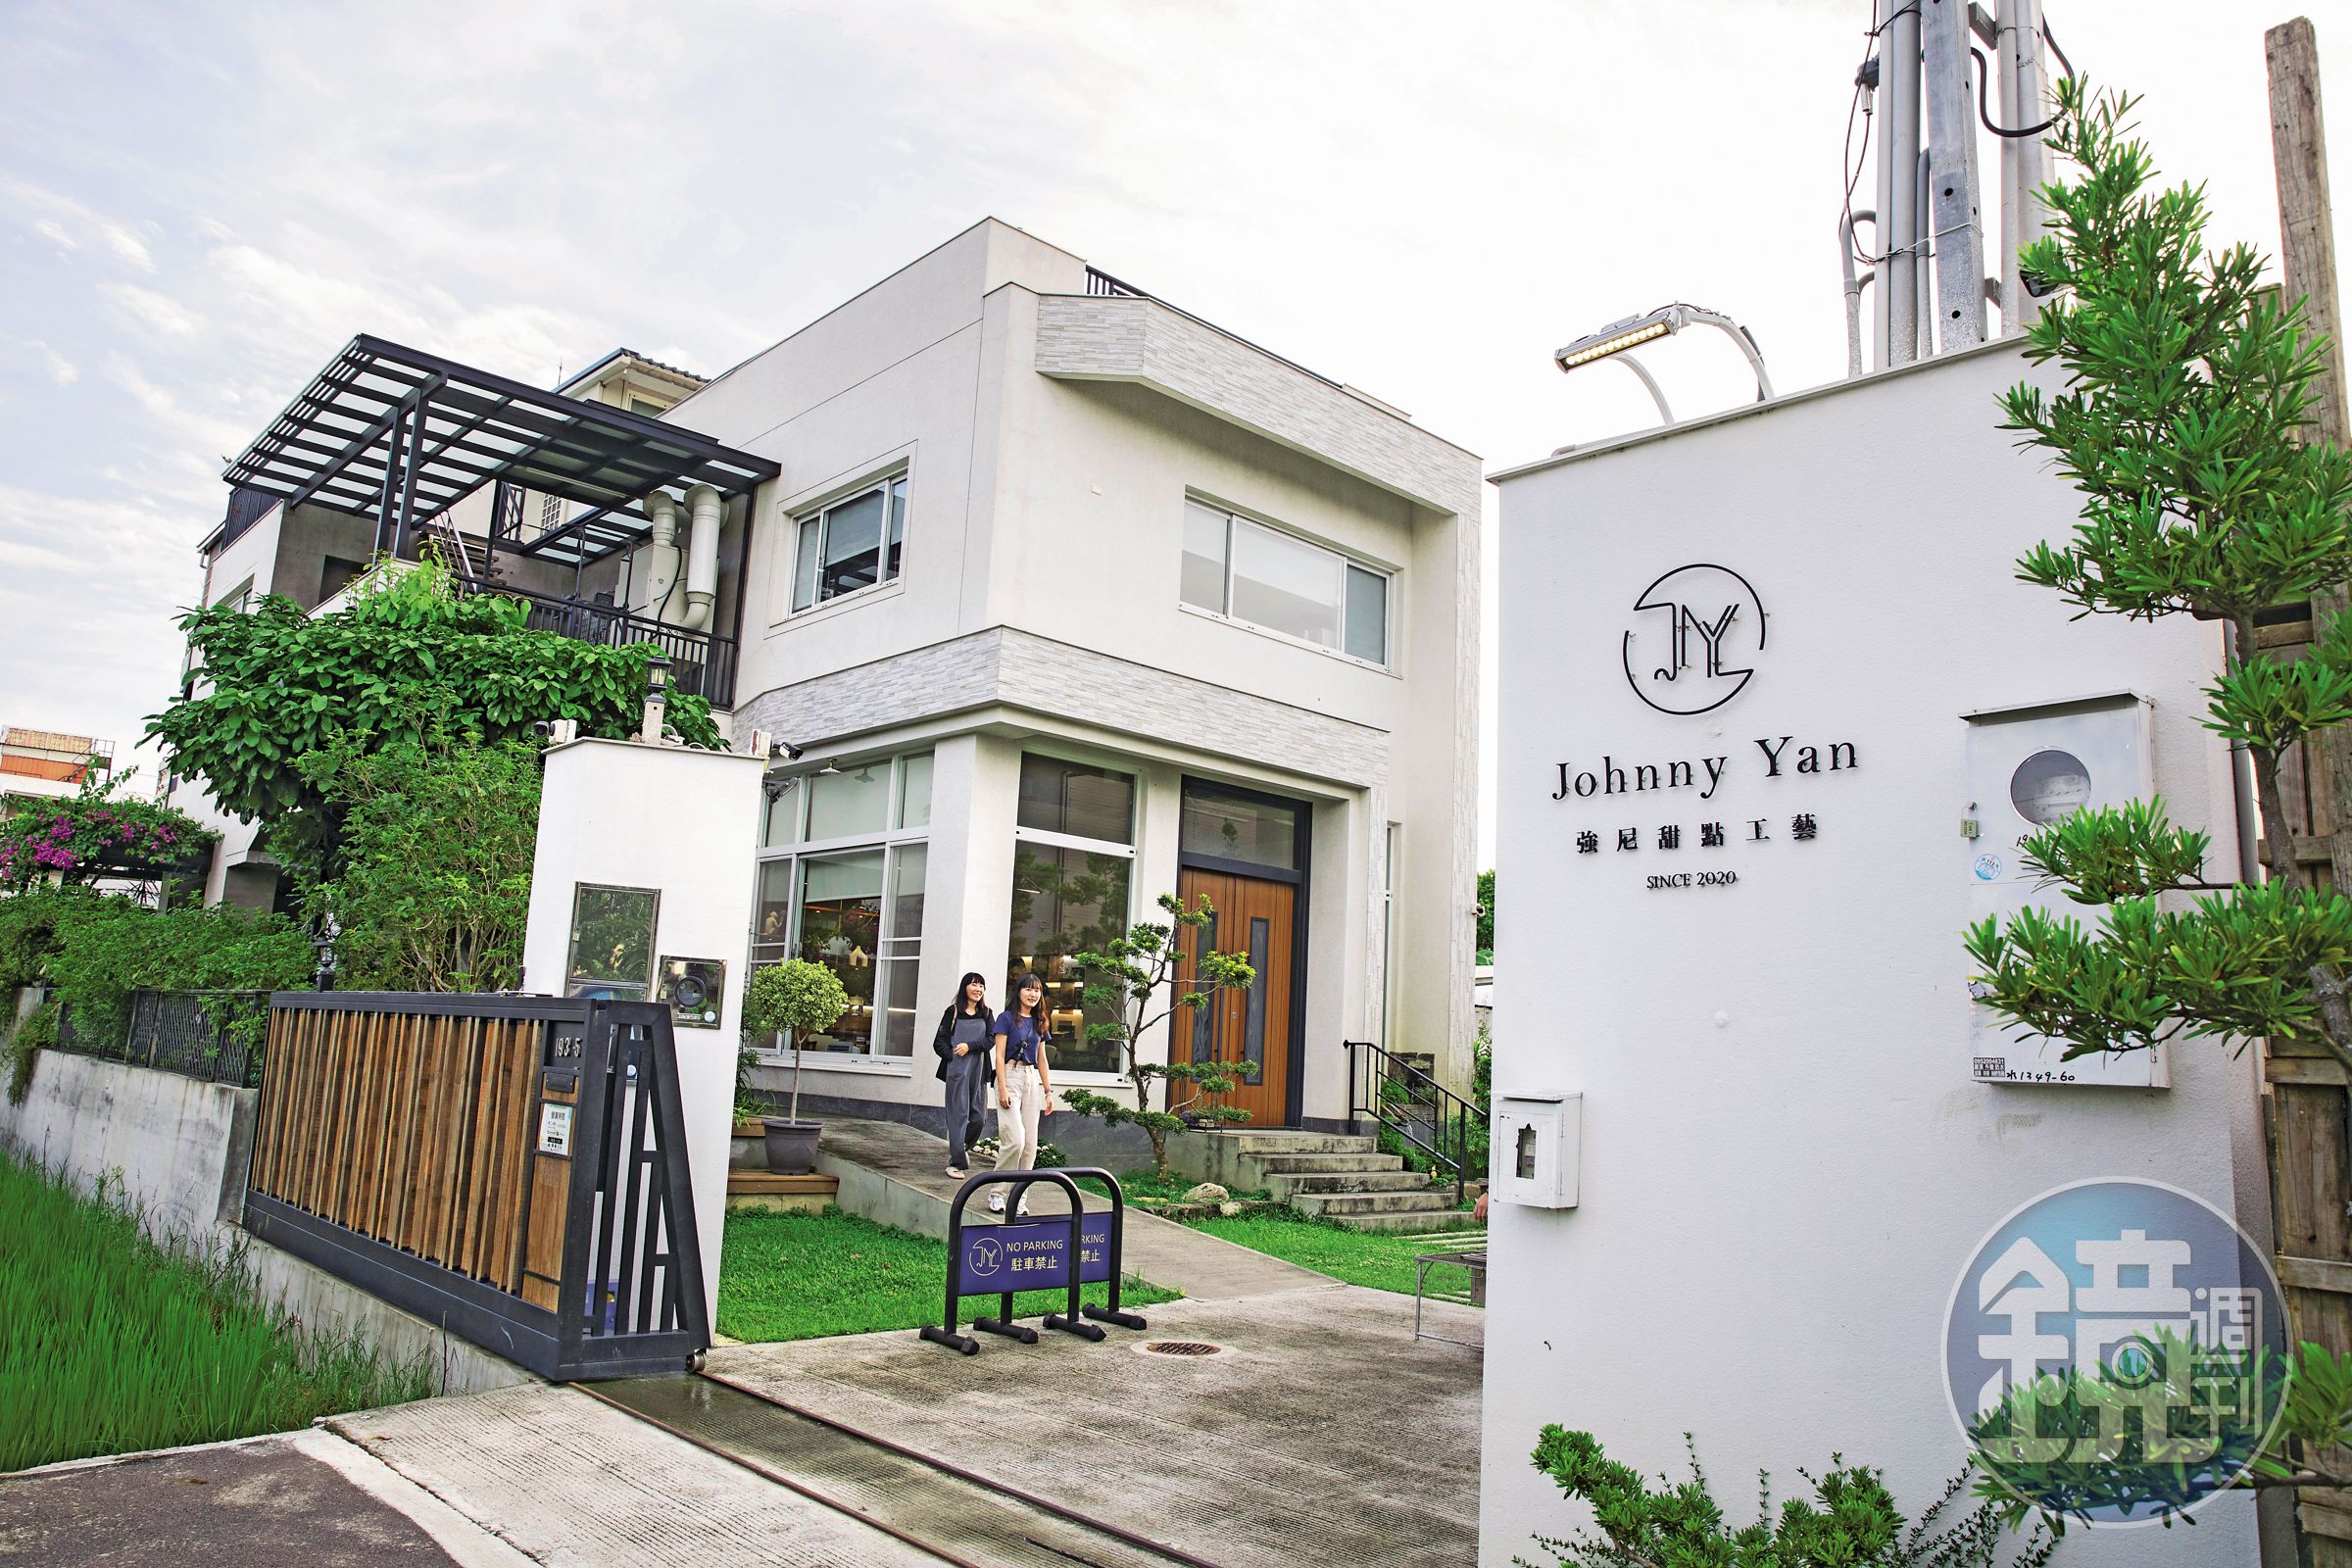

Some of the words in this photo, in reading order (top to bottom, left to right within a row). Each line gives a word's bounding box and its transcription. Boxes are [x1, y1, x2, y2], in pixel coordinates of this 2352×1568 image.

[1551, 756, 1728, 801] Johnny
[1753, 736, 1859, 778] Yan
[1576, 813, 1817, 855] 強尼甜點工藝
[1646, 873, 1691, 890] SINCE
[1696, 870, 1737, 887] 2020
[1006, 1242, 1021, 1252] NO
[1023, 1239, 1063, 1251] PARKING
[1081, 1234, 1105, 1245] RKING
[1010, 1255, 1058, 1272] 駐車禁止
[1081, 1249, 1101, 1263] 禁止
